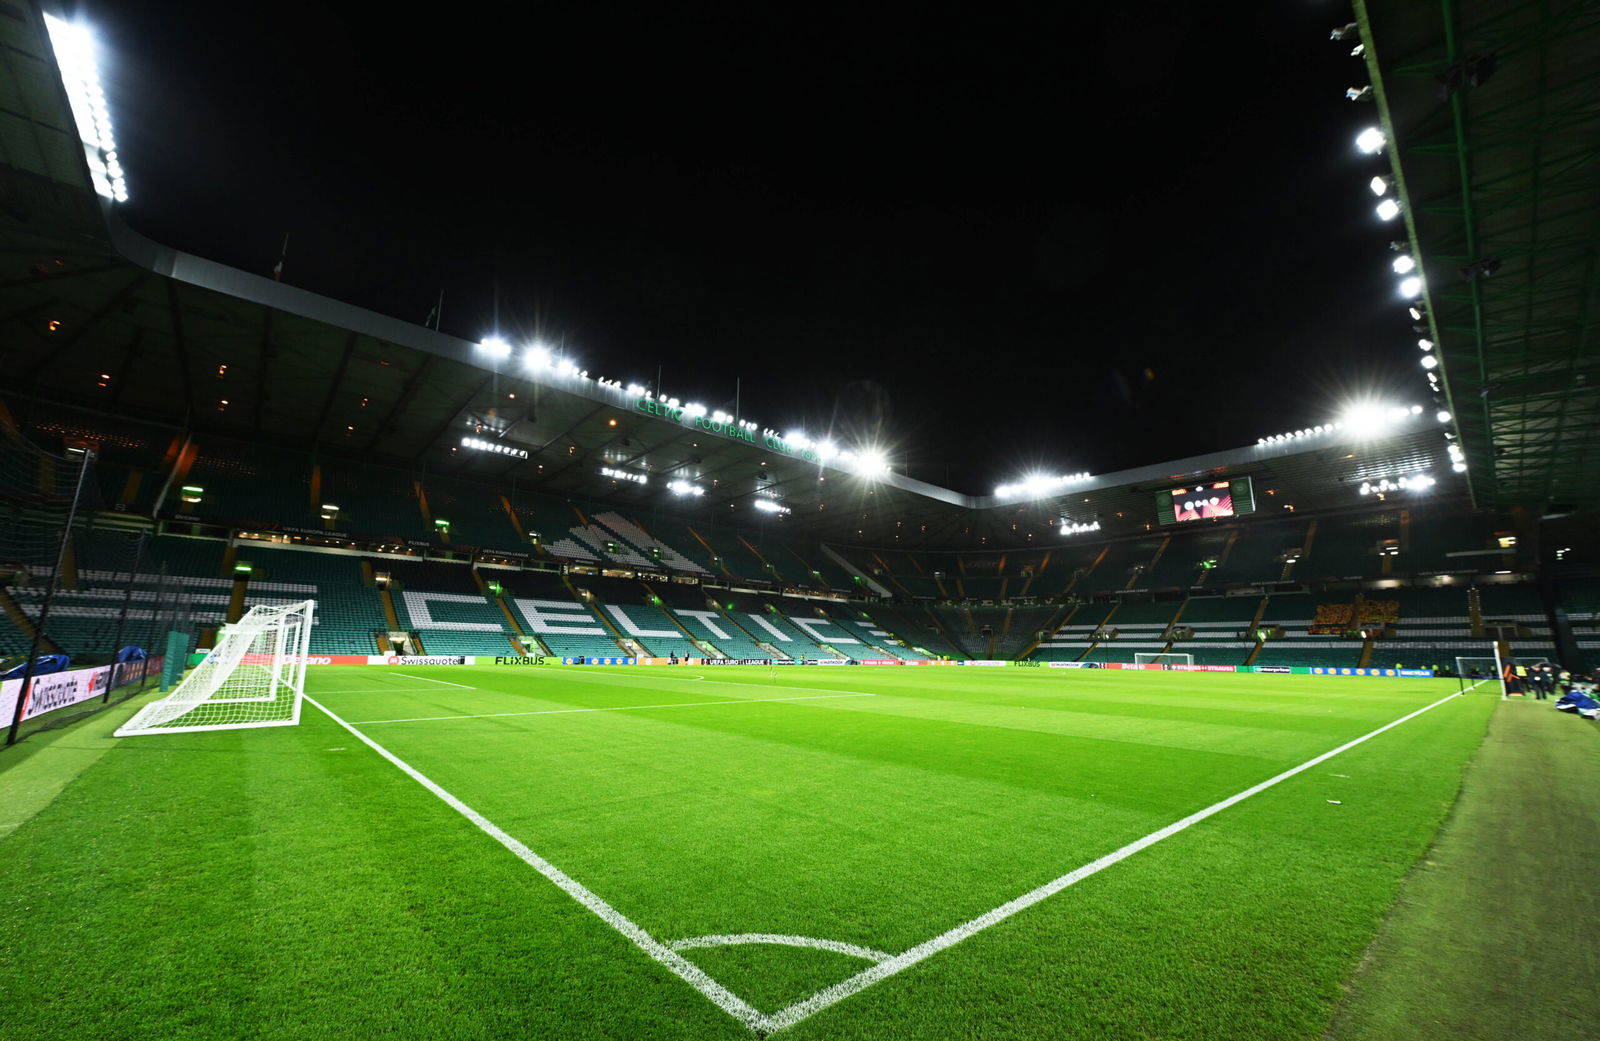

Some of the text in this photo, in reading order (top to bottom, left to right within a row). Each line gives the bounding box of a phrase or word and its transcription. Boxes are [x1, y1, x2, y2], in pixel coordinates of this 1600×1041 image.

[636, 399, 684, 422] CELTIC
[694, 416, 755, 443] FOOTBALL
[764, 436, 794, 455] CLUB
[402, 590, 860, 645] CELTIC
